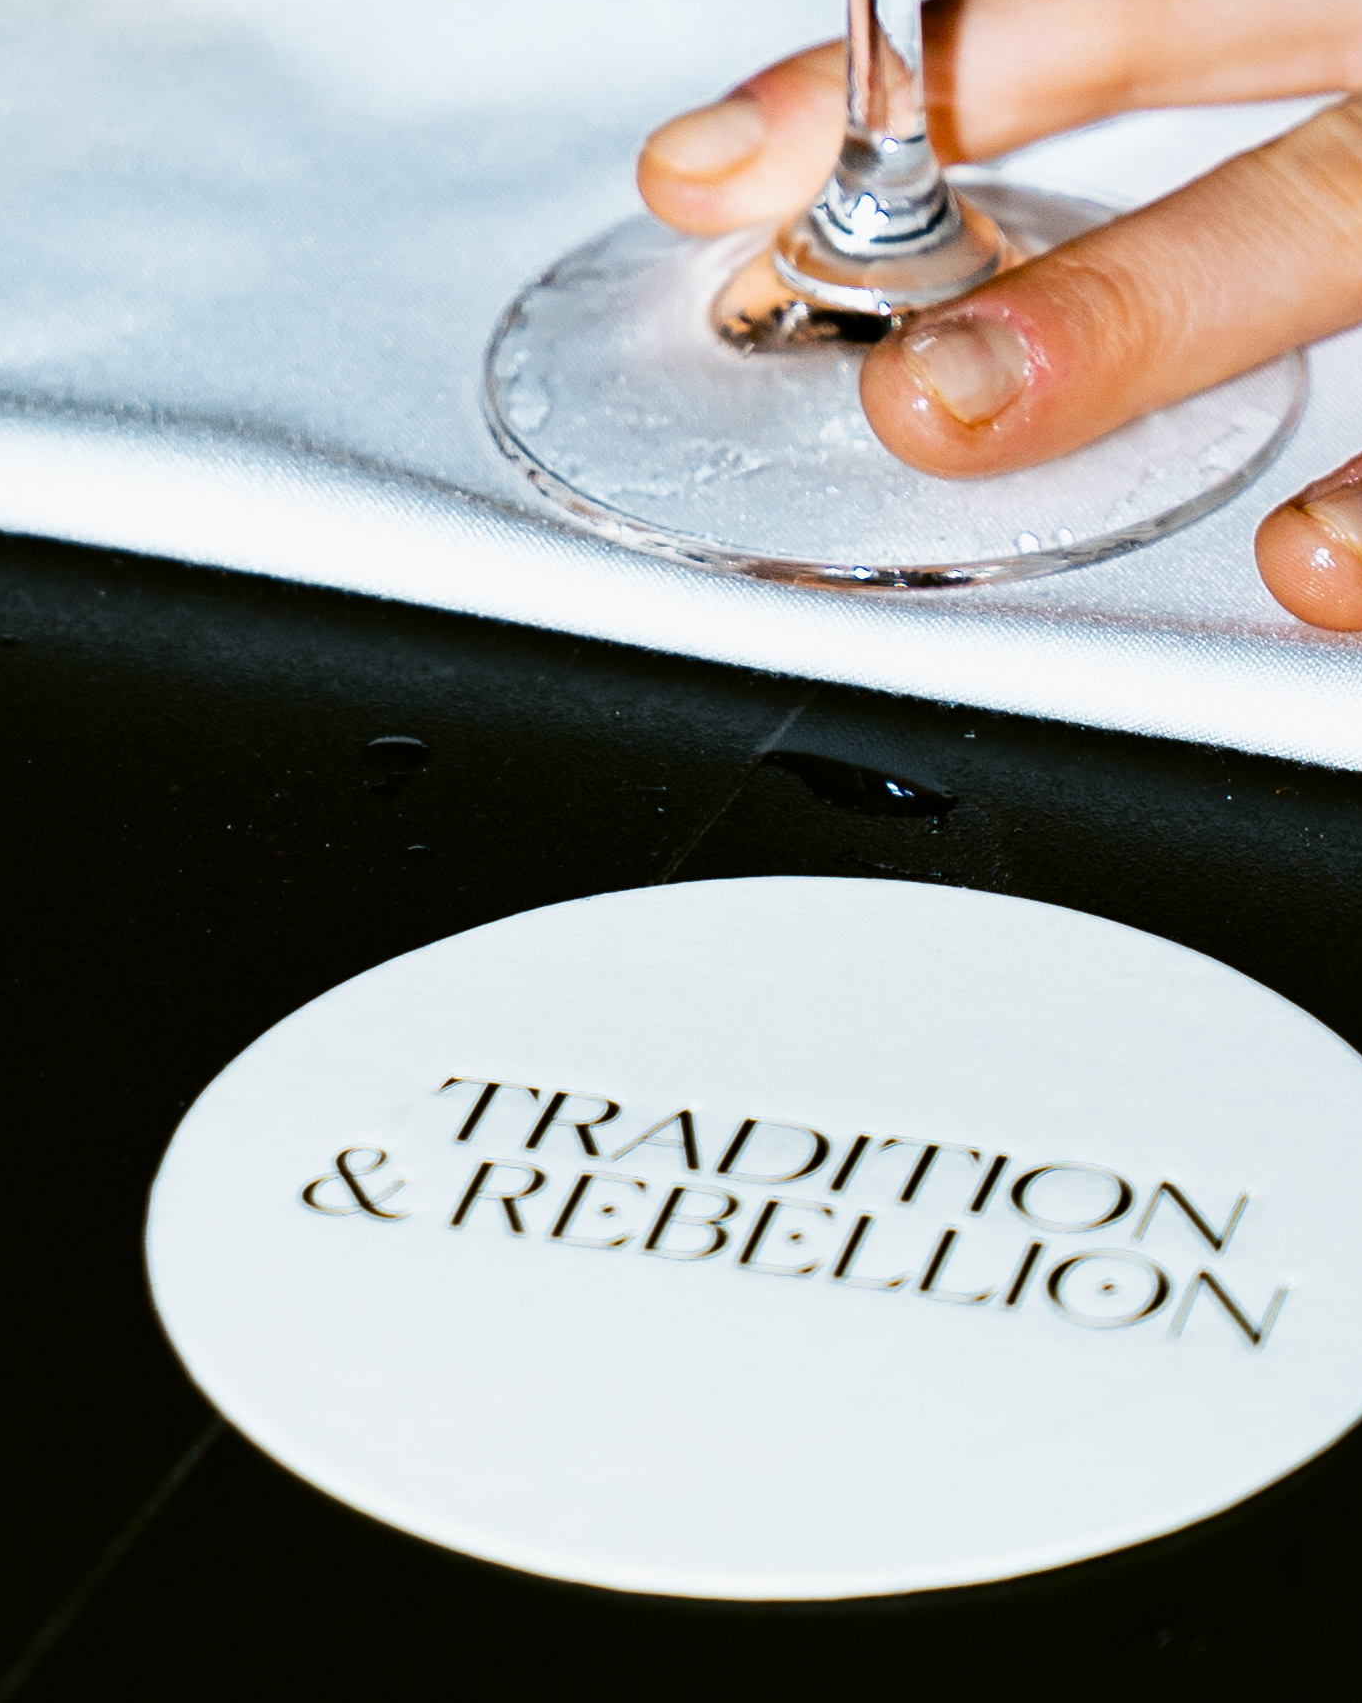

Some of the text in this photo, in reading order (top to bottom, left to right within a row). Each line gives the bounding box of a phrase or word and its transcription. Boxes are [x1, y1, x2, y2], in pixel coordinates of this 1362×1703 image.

[299, 1144, 1289, 1349] & REBELLION
[439, 1076, 1251, 1253] TRADITION
